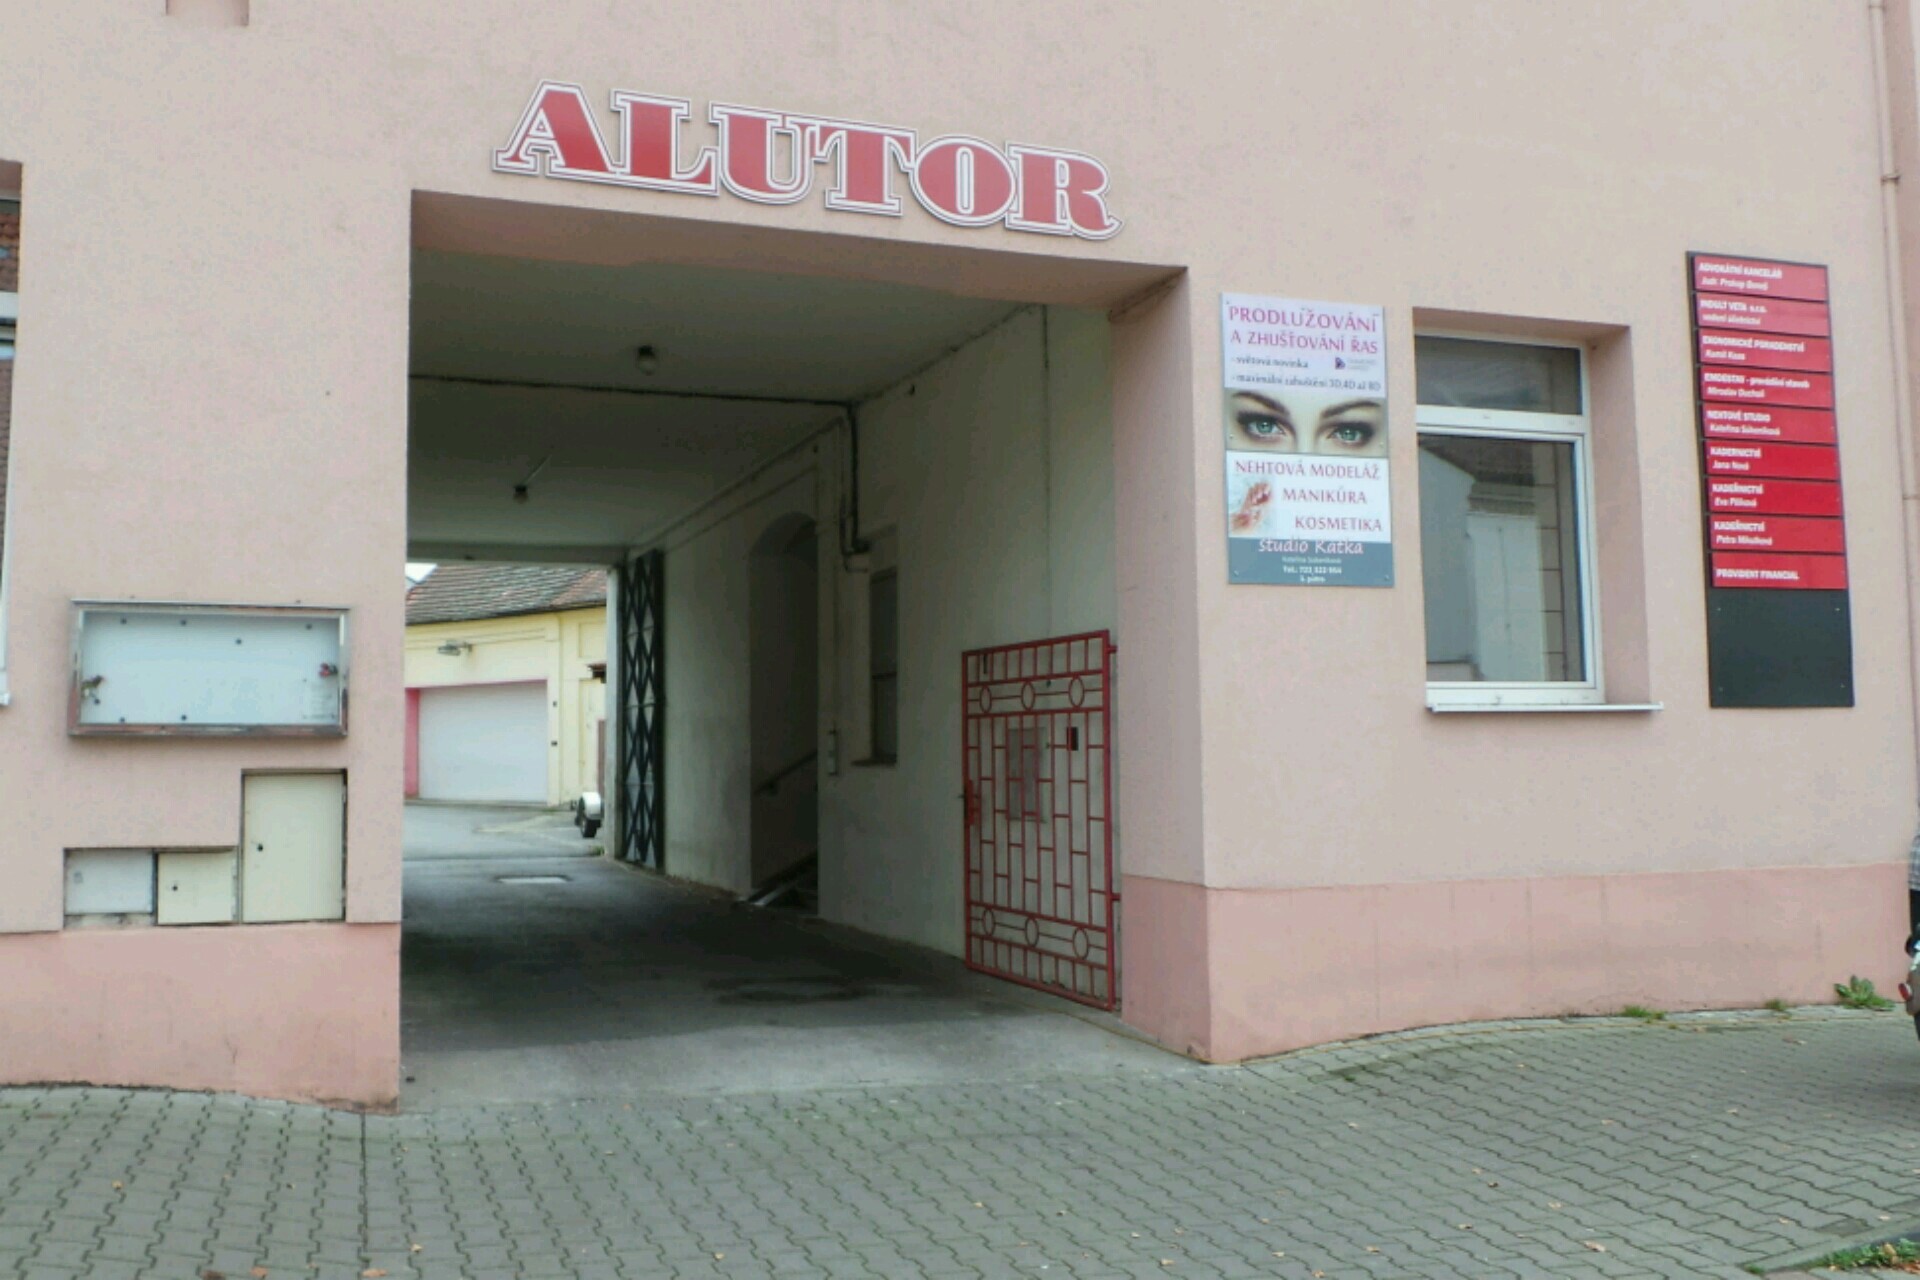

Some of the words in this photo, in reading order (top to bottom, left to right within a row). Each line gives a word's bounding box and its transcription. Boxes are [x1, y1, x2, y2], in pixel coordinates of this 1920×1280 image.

[492, 79, 1124, 240] ALUTOR
[1228, 305, 1380, 332] PRODLUŽOVÁNÍ
[1230, 329, 1242, 344] A
[1236, 355, 1271, 367] světová
[1272, 356, 1309, 369] novinka
[1743, 411, 1771, 423] STUDIO
[1234, 459, 1306, 477] NEHTOVÁ
[1310, 461, 1380, 481] MODELÁŽ
[1282, 486, 1368, 504] MANIKÚRA
[1295, 515, 1383, 532] KOSMETIKA
[1258, 536, 1309, 553] Studio
[1315, 538, 1364, 555] Katka
[1716, 568, 1759, 579] PROVIDENT
[1760, 570, 1800, 580] FINANCIAL
